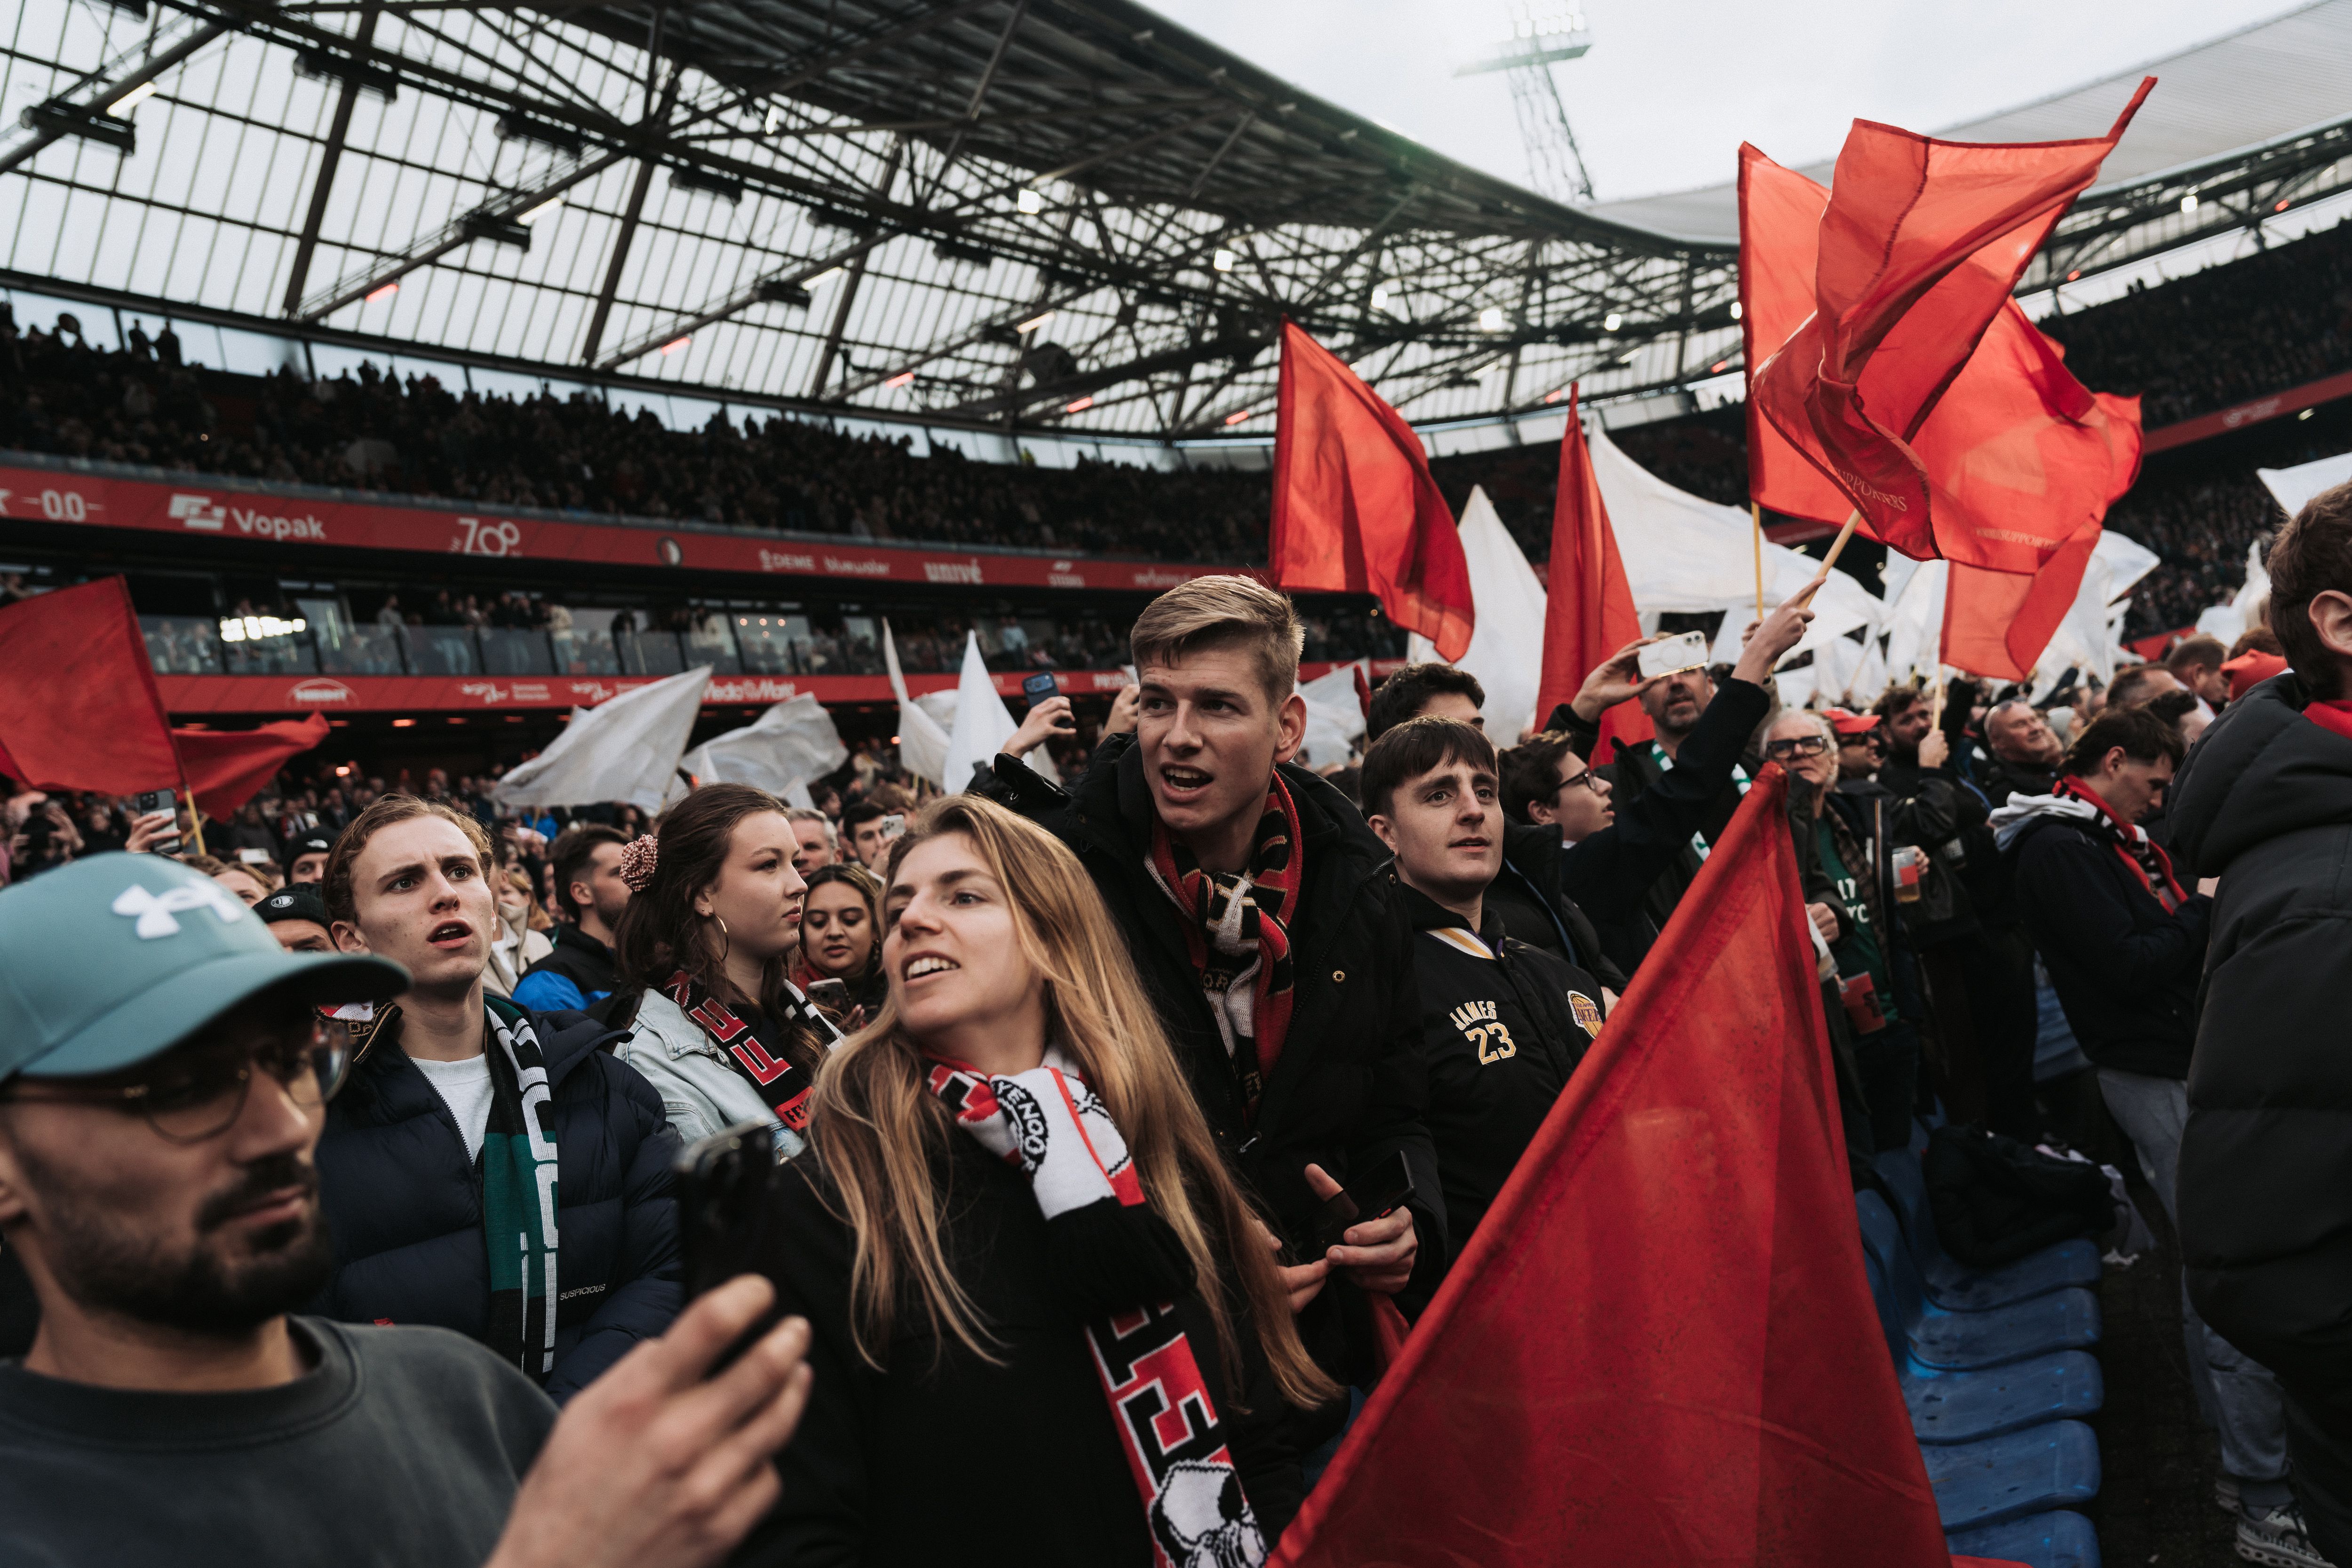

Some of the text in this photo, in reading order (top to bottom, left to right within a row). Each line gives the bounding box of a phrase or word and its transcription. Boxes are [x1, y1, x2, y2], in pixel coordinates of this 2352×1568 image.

[230, 507, 326, 541] Vopak
[1449, 1001, 1497, 1031] JAMES
[1464, 1022, 1517, 1065] 23
[560, 1283, 606, 1301] SUSPICIOUS
